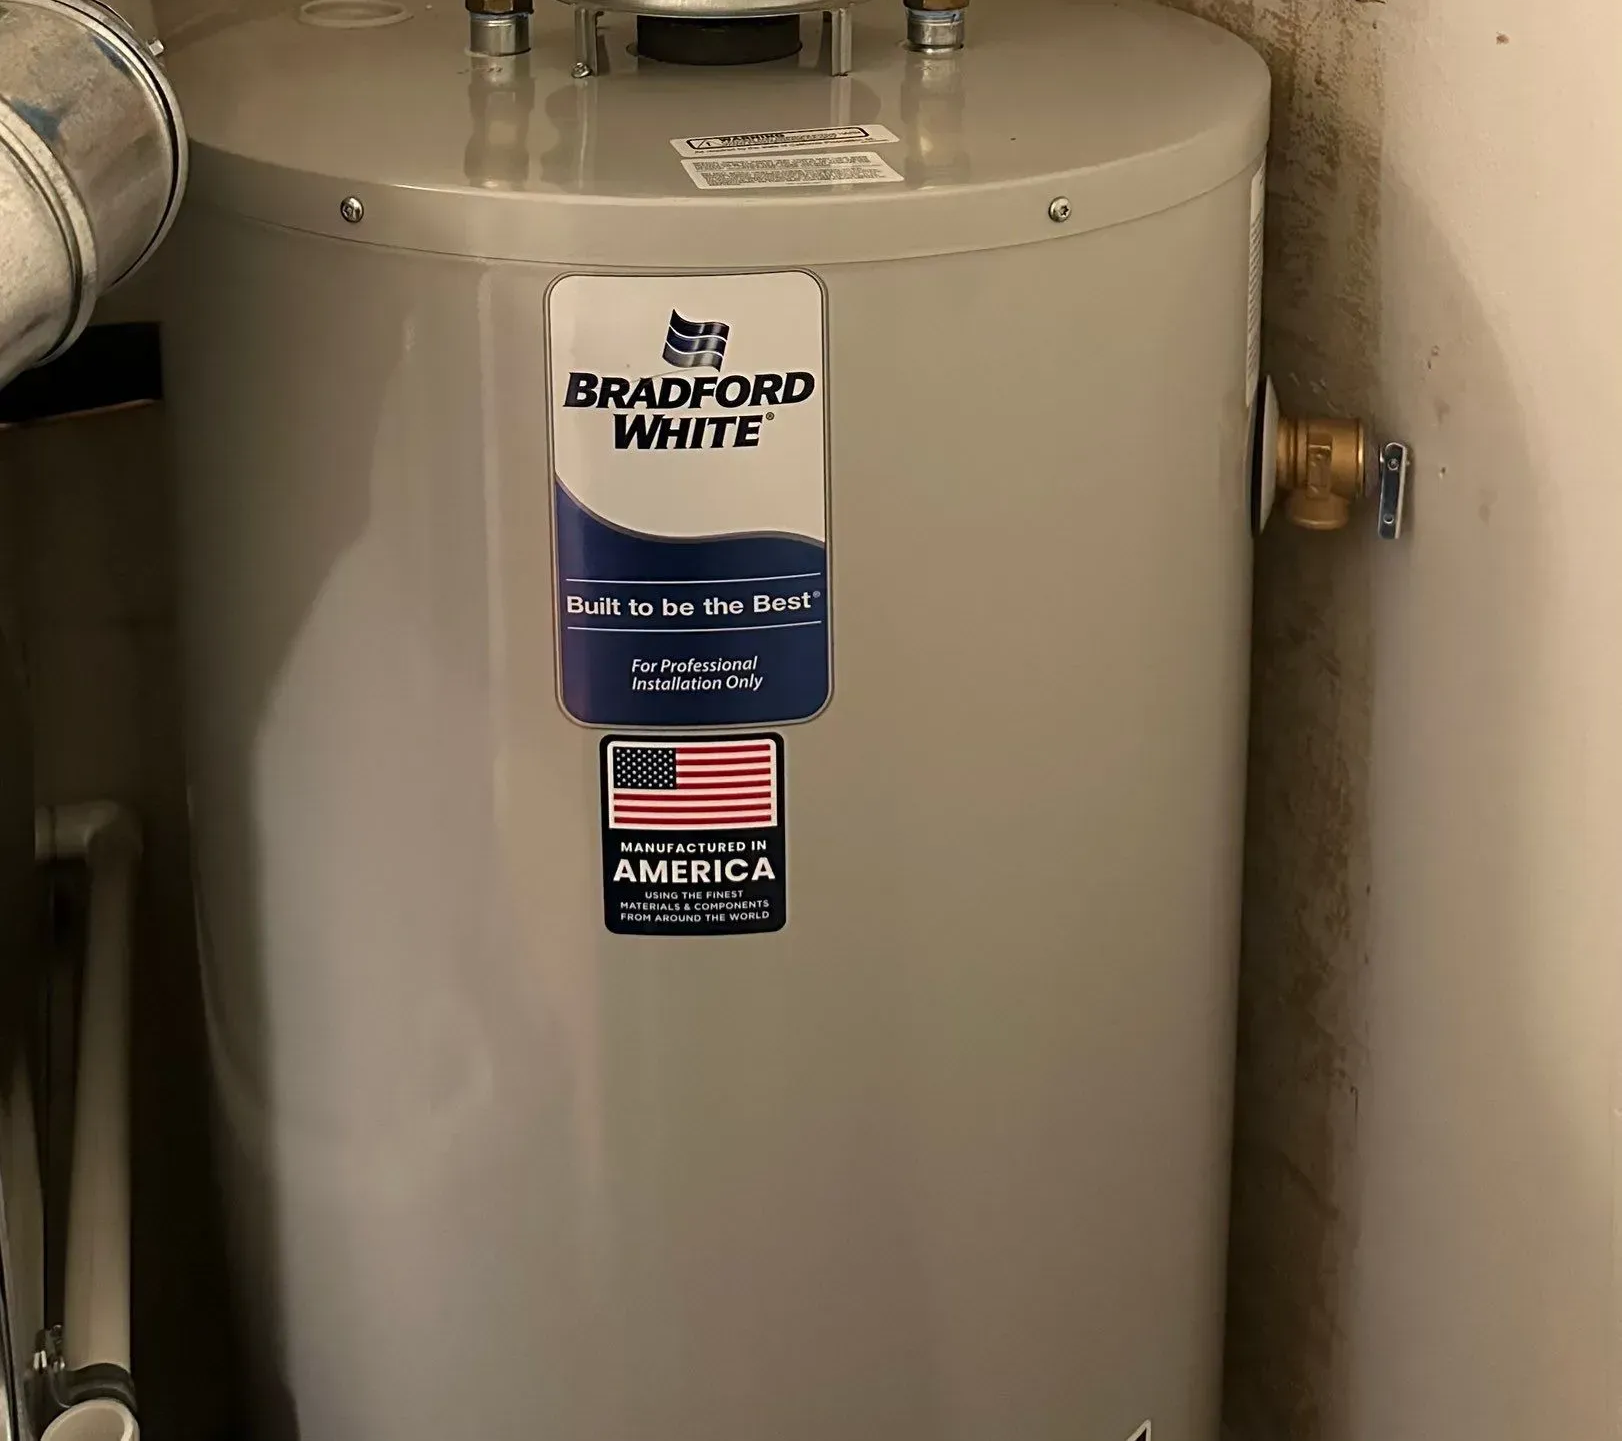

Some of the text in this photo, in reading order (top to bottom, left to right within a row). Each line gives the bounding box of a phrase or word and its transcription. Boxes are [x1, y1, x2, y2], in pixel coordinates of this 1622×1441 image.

[562, 371, 816, 409] BRADFORD
[566, 595, 621, 615] Built
[628, 599, 654, 617] to
[662, 598, 695, 617] be
[703, 597, 744, 615] the
[632, 655, 758, 673] For Professional
[632, 673, 764, 692] Installation Only
[620, 840, 766, 853] MANUFACTURED IN
[613, 857, 776, 883] AMERICA
[645, 889, 744, 899] USING THE FINEST
[620, 899, 770, 911] MATERIALS & COMPONENTS
[620, 911, 770, 923] FROM AROUND THE WORLD
